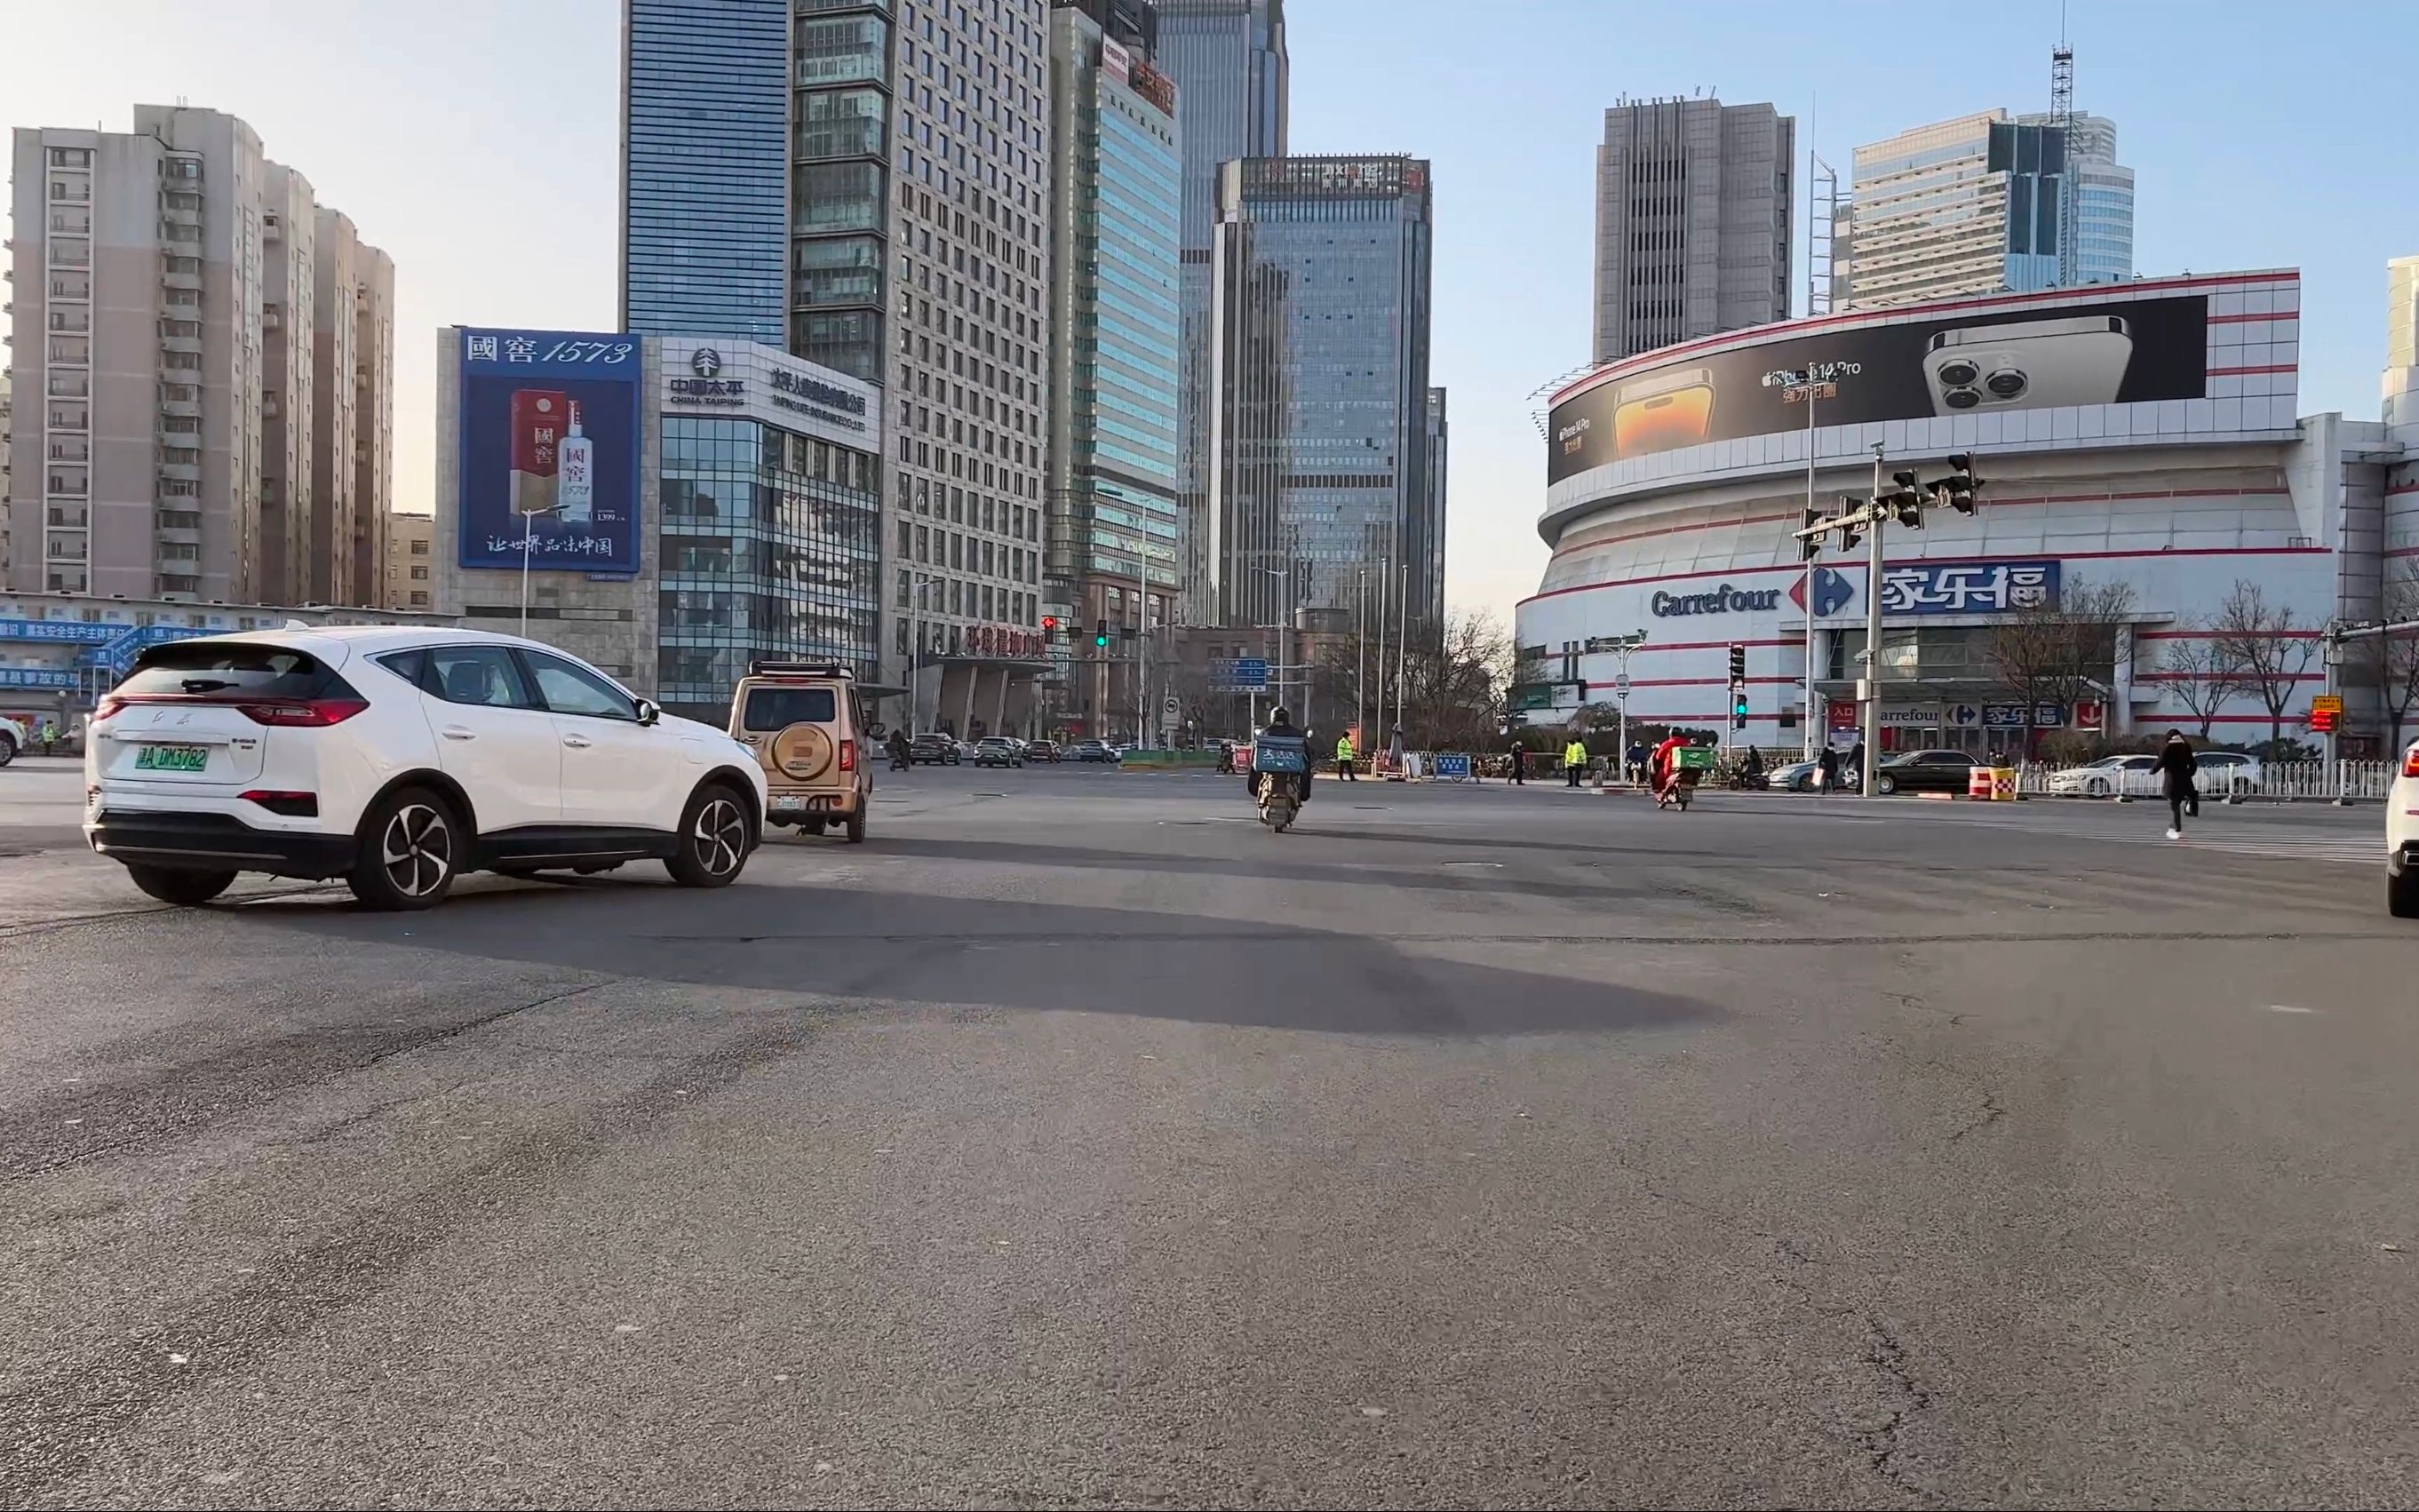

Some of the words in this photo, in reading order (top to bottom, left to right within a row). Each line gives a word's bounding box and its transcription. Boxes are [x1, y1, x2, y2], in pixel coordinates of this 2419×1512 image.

[1772, 368, 1818, 386] iPhoe
[1819, 362, 1835, 381] 14
[1837, 361, 1861, 380] Pro
[670, 378, 744, 395] 中国太平
[671, 396, 702, 405] CHINA
[704, 397, 744, 407] TAIPING
[1882, 566, 2047, 611] 家乐福
[1651, 583, 1780, 617] Carrefour
[1834, 706, 1853, 717] 入口
[1880, 708, 1938, 722] arrefour
[1985, 707, 2057, 725] 家乐福
